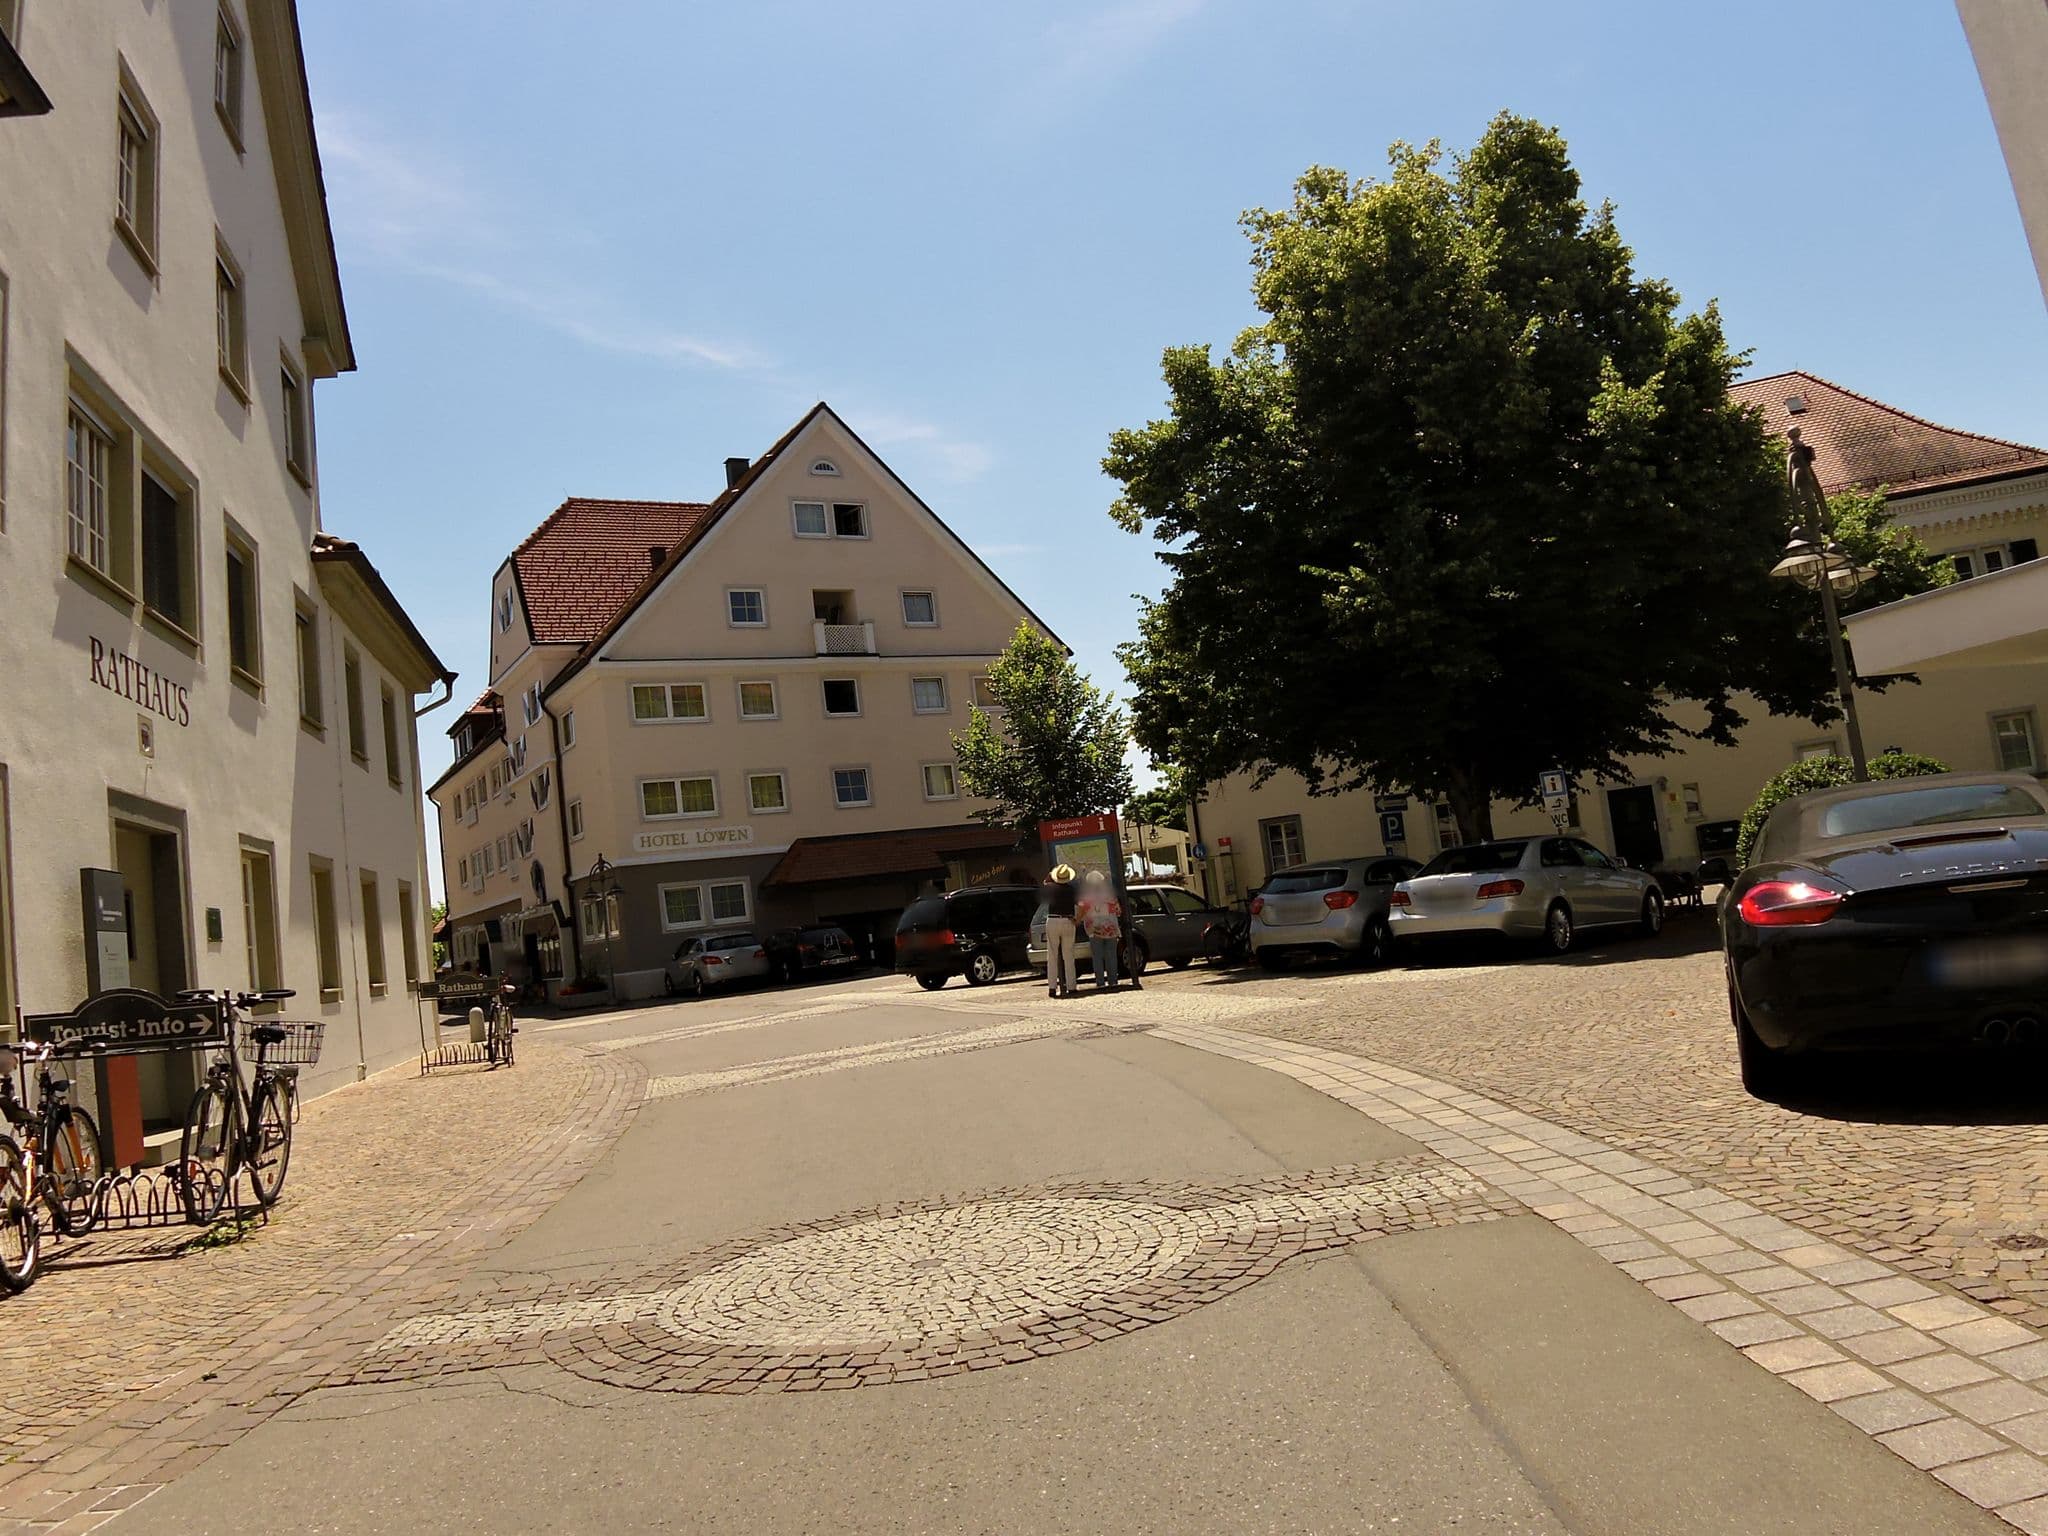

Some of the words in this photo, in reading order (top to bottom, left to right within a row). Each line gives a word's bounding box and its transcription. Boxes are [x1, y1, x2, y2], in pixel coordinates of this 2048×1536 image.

[89, 635, 189, 727] RATHAUS
[1551, 813, 1568, 824] WC
[1052, 820, 1083, 830] Infopunkt
[640, 833, 688, 848] HOTEL
[696, 828, 748, 844] LÖWEN
[1053, 829, 1079, 837] Rathaus
[438, 982, 484, 993] Rathaus
